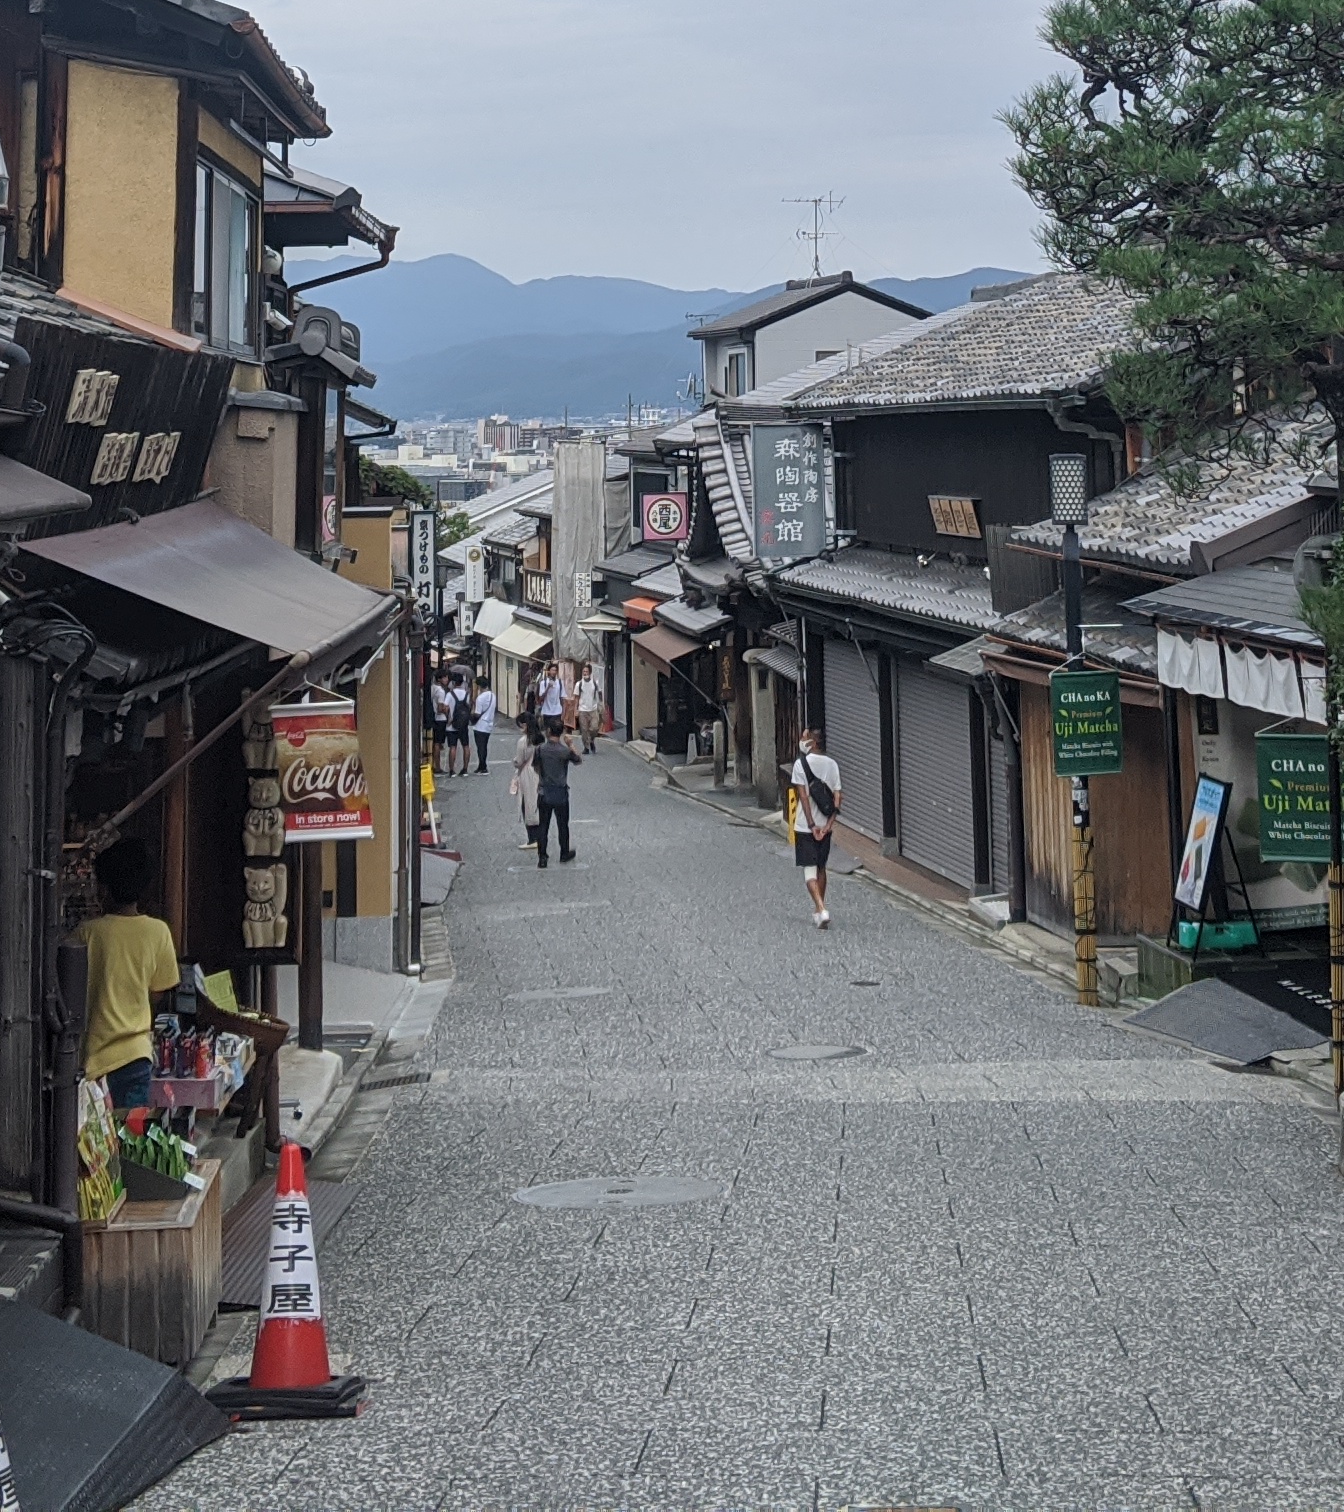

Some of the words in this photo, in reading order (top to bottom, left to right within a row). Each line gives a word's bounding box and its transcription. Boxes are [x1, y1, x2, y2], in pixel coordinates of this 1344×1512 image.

[773, 438, 804, 542] 森陶器館
[657, 504, 672, 529] 西尾
[1060, 692, 1083, 703] CHA
[1096, 691, 1111, 701] KA
[1055, 722, 1073, 738] Uji
[1077, 719, 1118, 734] Matcha
[1271, 759, 1306, 772] CHA
[1307, 763, 1325, 772] no
[1287, 781, 1330, 792] Premiu
[1263, 795, 1291, 814] Uji
[307, 813, 334, 824] store
[266, 1203, 315, 1314] 寺子屋
